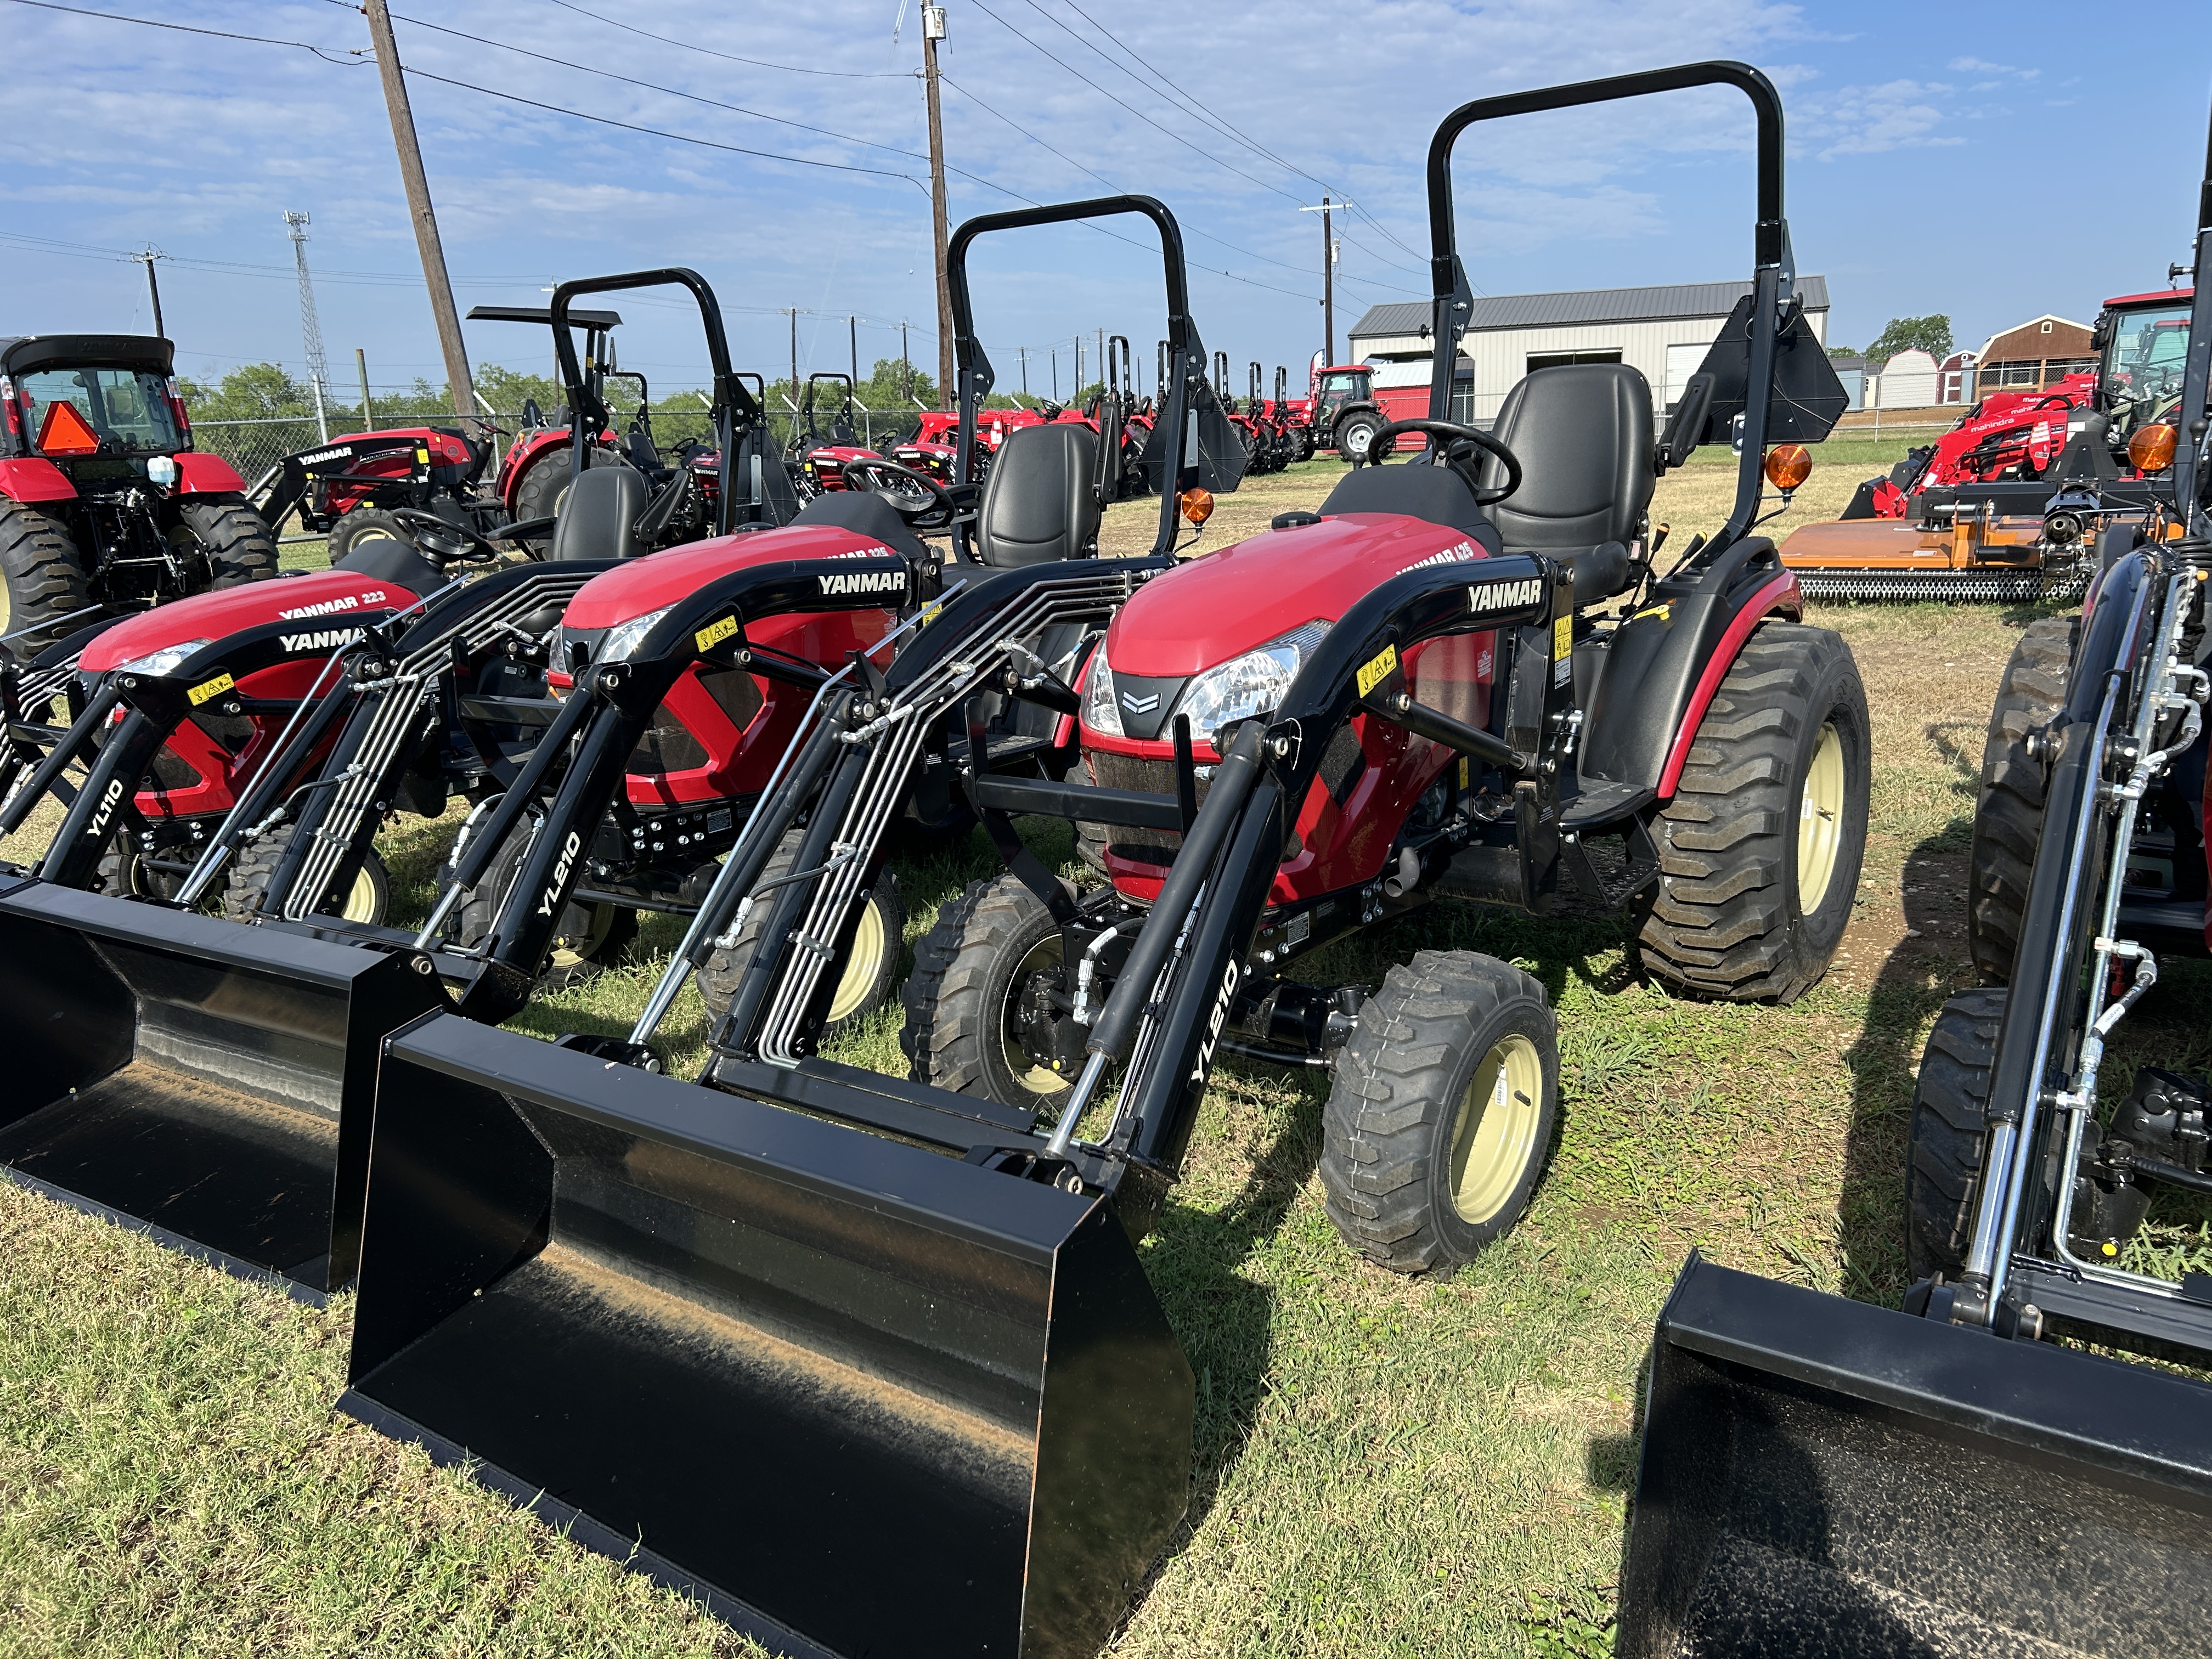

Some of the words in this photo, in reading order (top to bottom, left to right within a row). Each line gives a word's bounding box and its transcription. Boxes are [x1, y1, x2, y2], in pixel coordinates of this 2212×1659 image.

[298, 447, 352, 465] YANMAR
[1395, 549, 1457, 575] NMAR
[819, 572, 905, 594] YANMAR
[1469, 579, 1542, 612] YANMAR
[279, 596, 358, 620] YANMAR
[362, 591, 386, 604] 223
[279, 626, 383, 652] YANMA
[87, 779, 123, 836] YL110
[538, 831, 580, 916] YL210
[1190, 959, 1238, 1083] YL210
